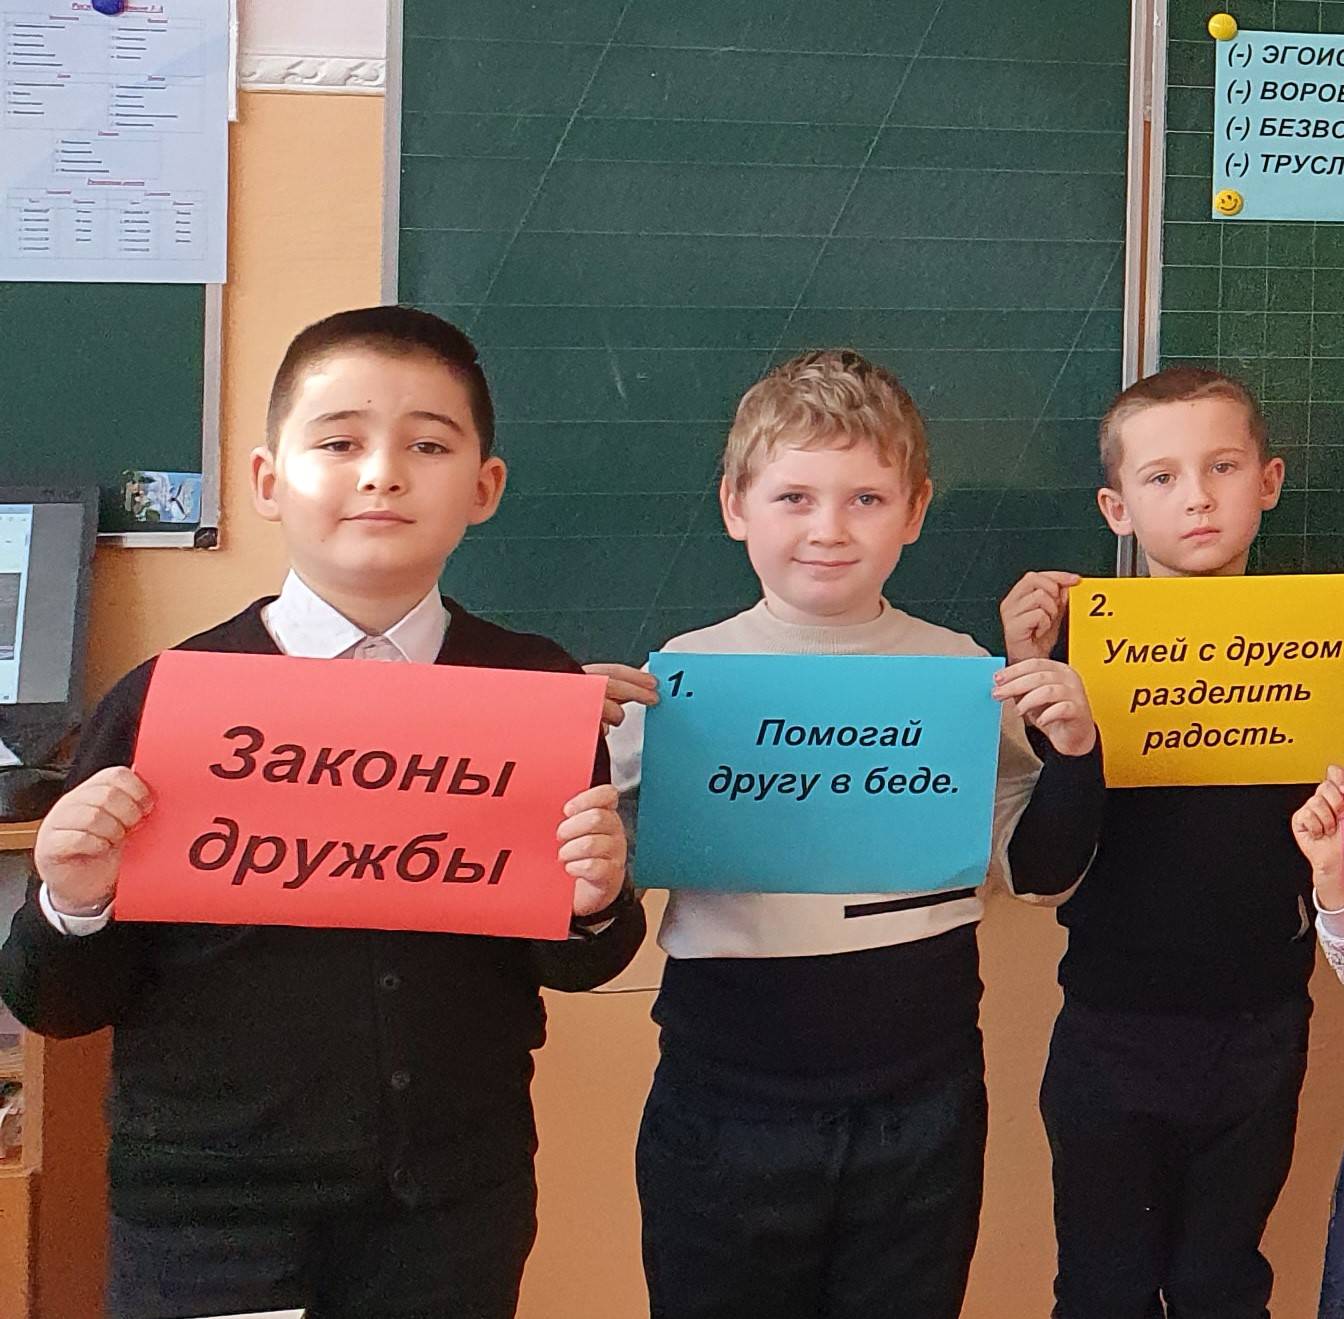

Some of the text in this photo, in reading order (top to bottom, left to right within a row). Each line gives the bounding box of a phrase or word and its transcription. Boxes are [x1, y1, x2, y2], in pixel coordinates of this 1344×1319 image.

[1228, 42, 1253, 68] (-)
[1227, 79, 1252, 105] (-)
[1226, 116, 1251, 141] (-)
[1225, 152, 1249, 178] (-)
[1089, 593, 1114, 617] 2.
[1103, 635, 1343, 667] Умей с другом
[668, 670, 693, 698] 1.
[1129, 679, 1311, 714] разделить
[755, 718, 923, 747] Помогай
[1141, 722, 1294, 756] радость.
[208, 725, 517, 798] Законы
[708, 765, 958, 802] другу в беде.
[188, 816, 513, 890] дружбы
